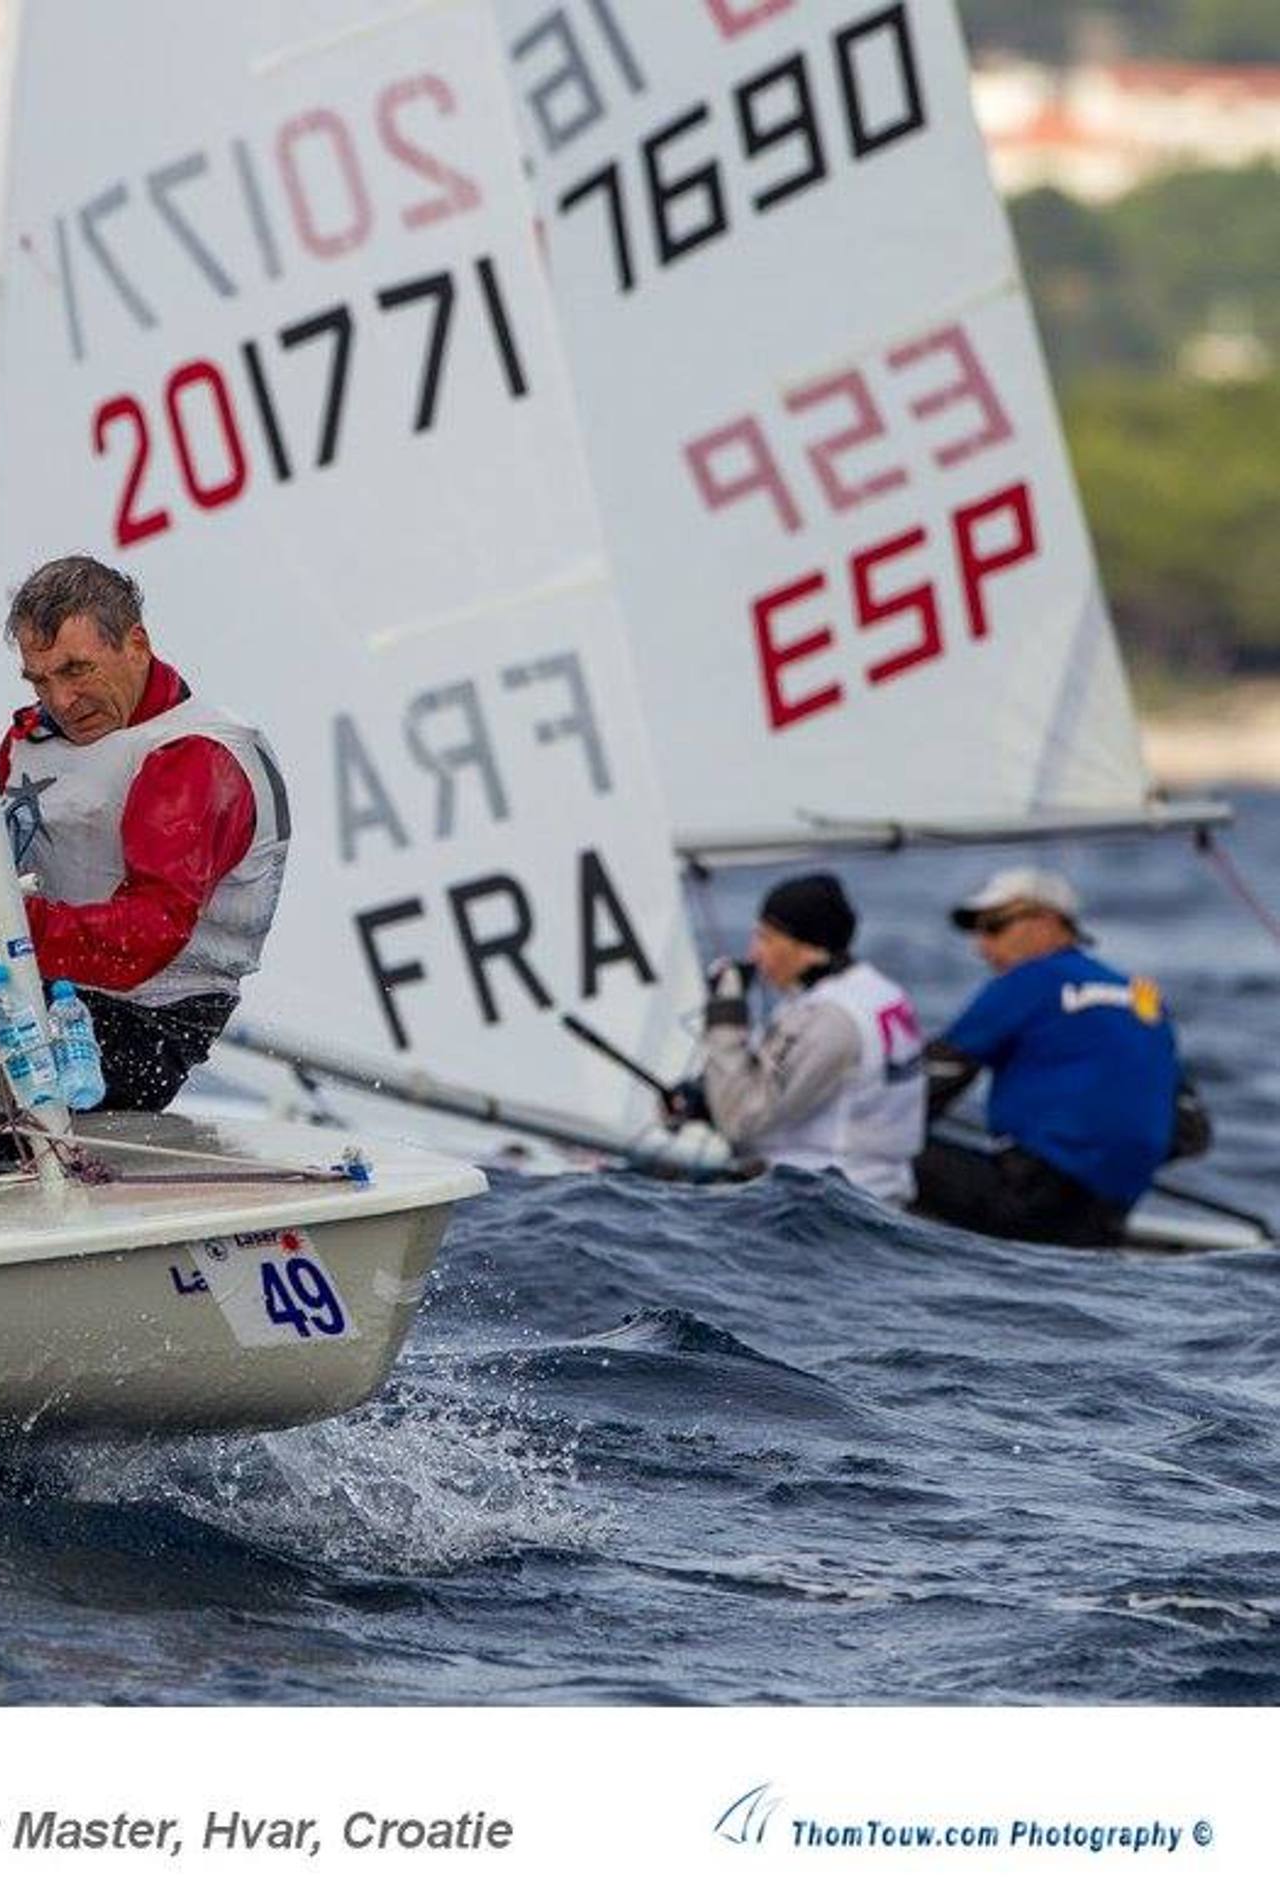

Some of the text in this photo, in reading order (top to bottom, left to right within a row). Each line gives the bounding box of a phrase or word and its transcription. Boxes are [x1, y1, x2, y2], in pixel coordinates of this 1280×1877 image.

[91, 256, 528, 548] 201771
[751, 482, 1041, 734] ESP
[354, 848, 658, 1052] FRA
[260, 1257, 345, 1338] 49
